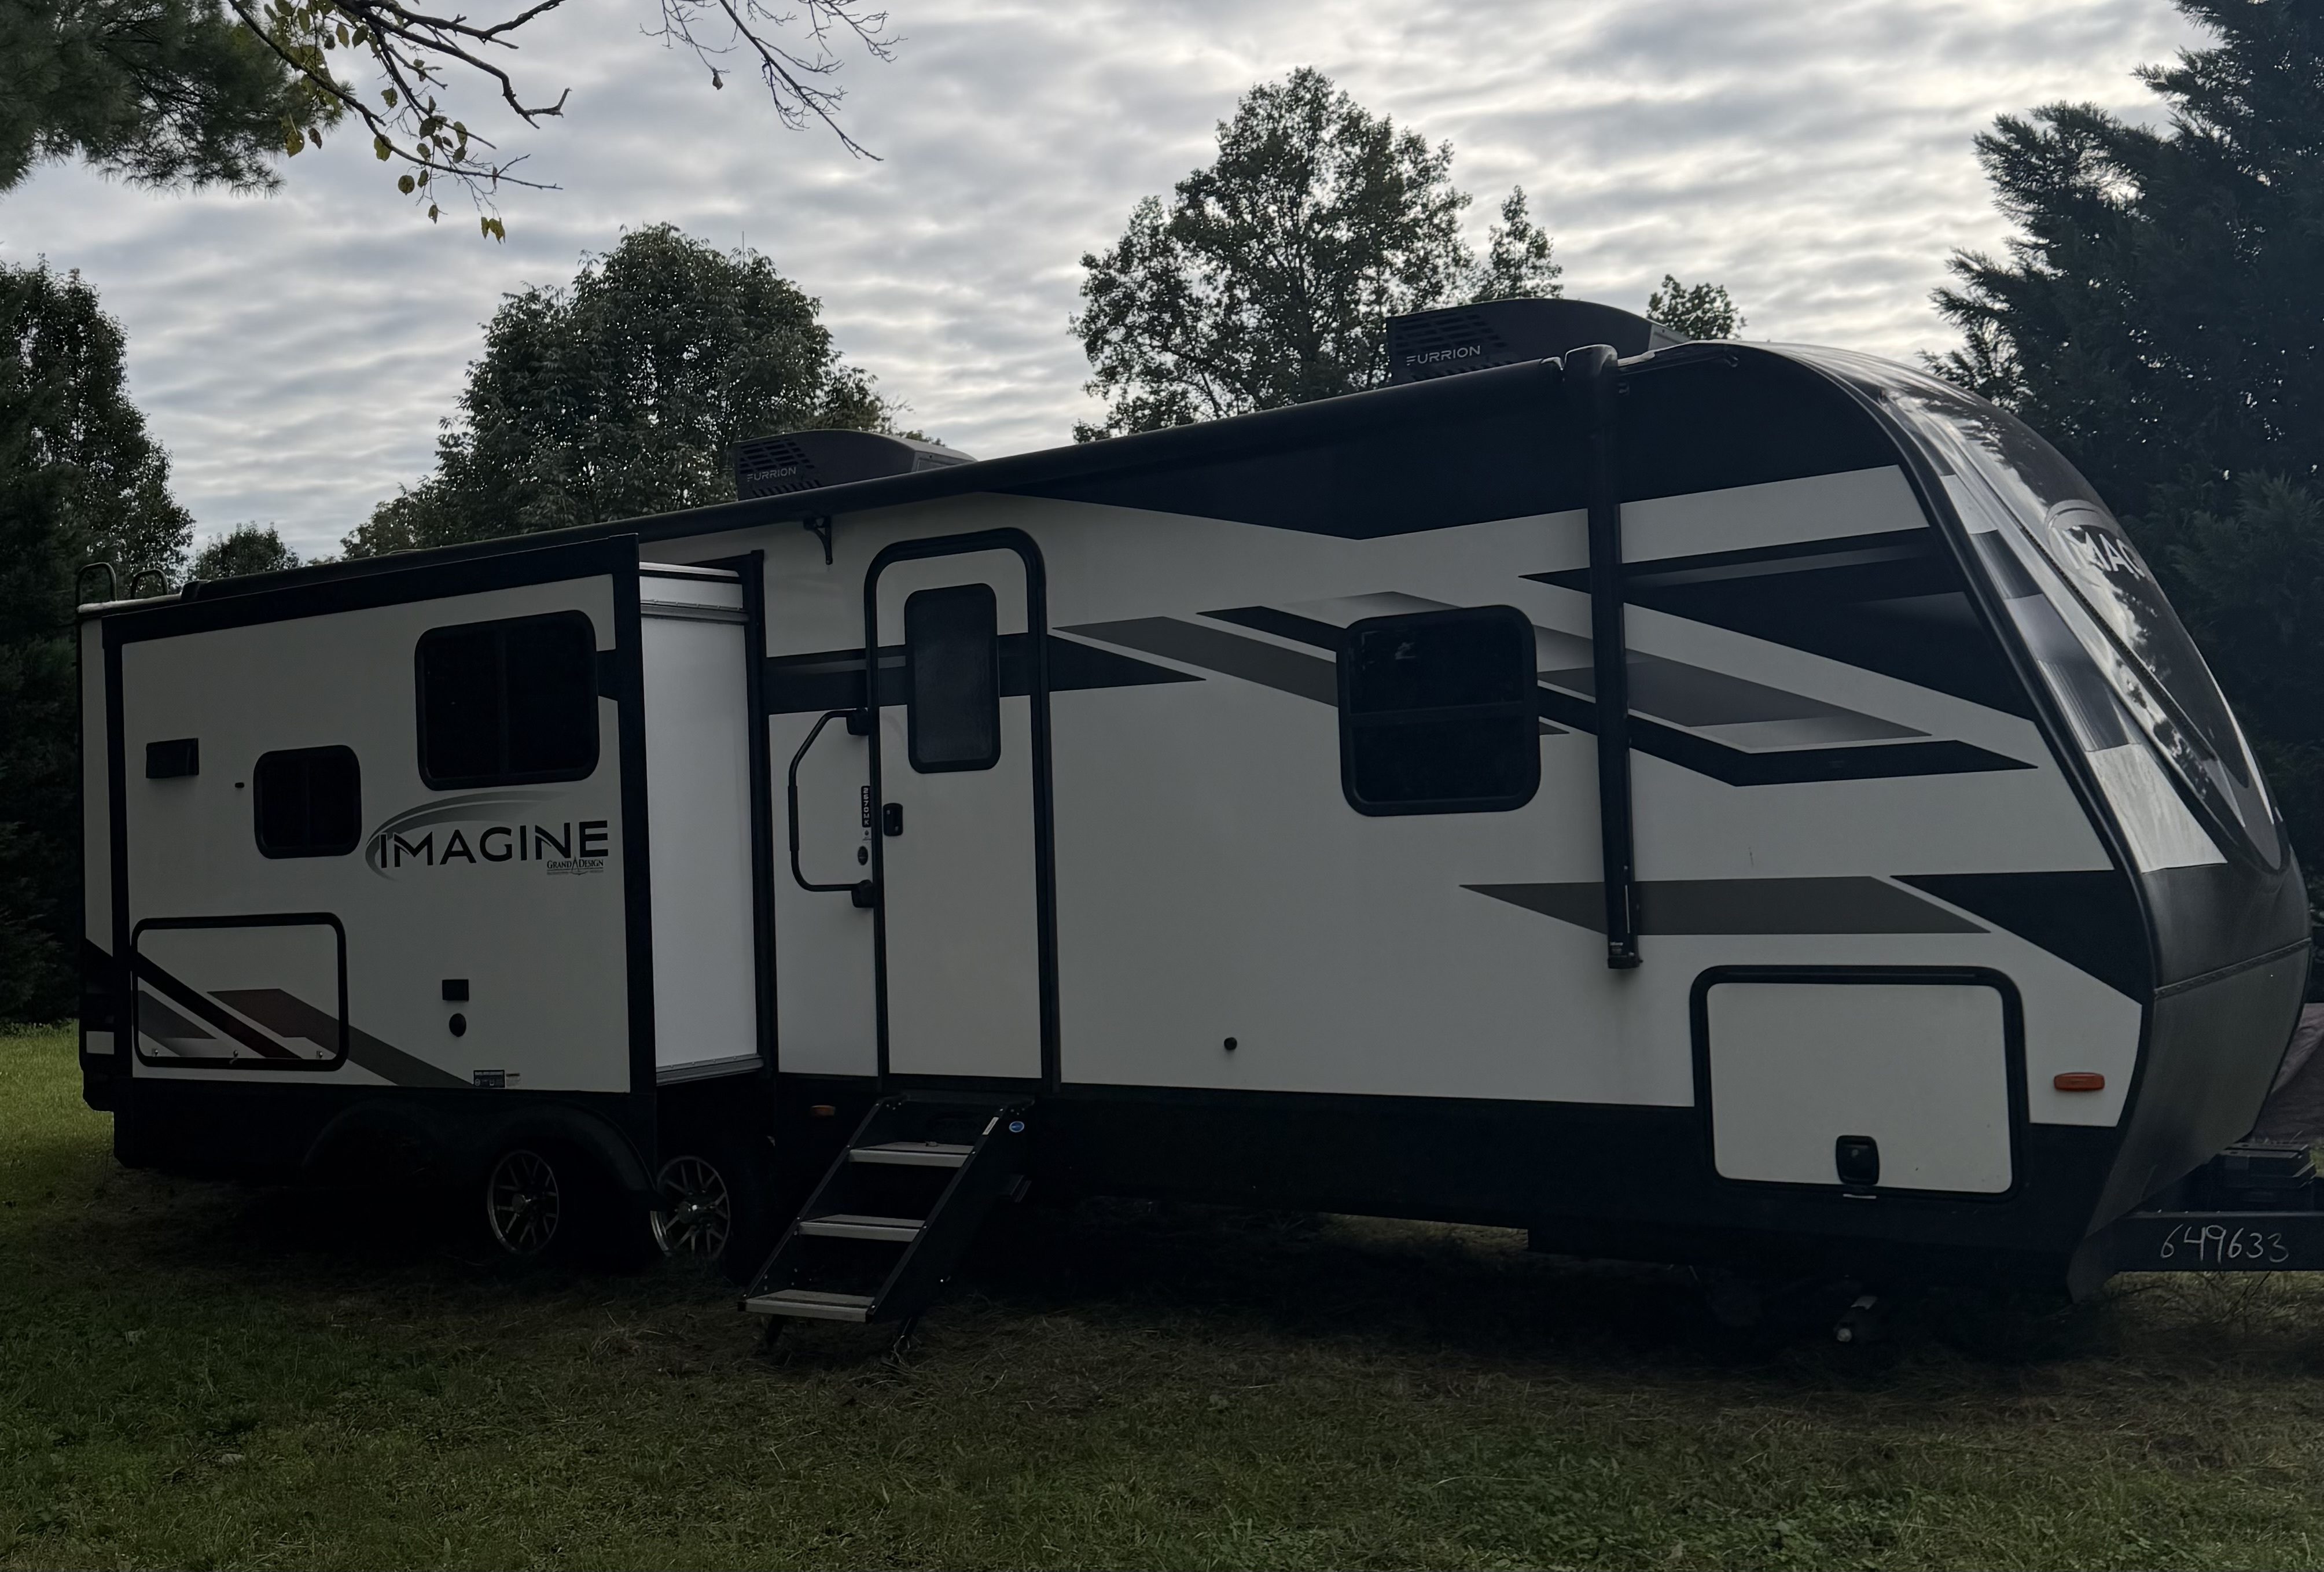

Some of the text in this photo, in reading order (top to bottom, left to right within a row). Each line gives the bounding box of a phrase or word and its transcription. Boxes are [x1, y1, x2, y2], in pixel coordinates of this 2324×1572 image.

[1406, 345, 1480, 366] FURRION
[747, 466, 796, 482] FURRION
[380, 820, 609, 868] IMAGINE
[547, 859, 604, 868] GRAND DESIGN
[2160, 1223, 2289, 1264] 649633
